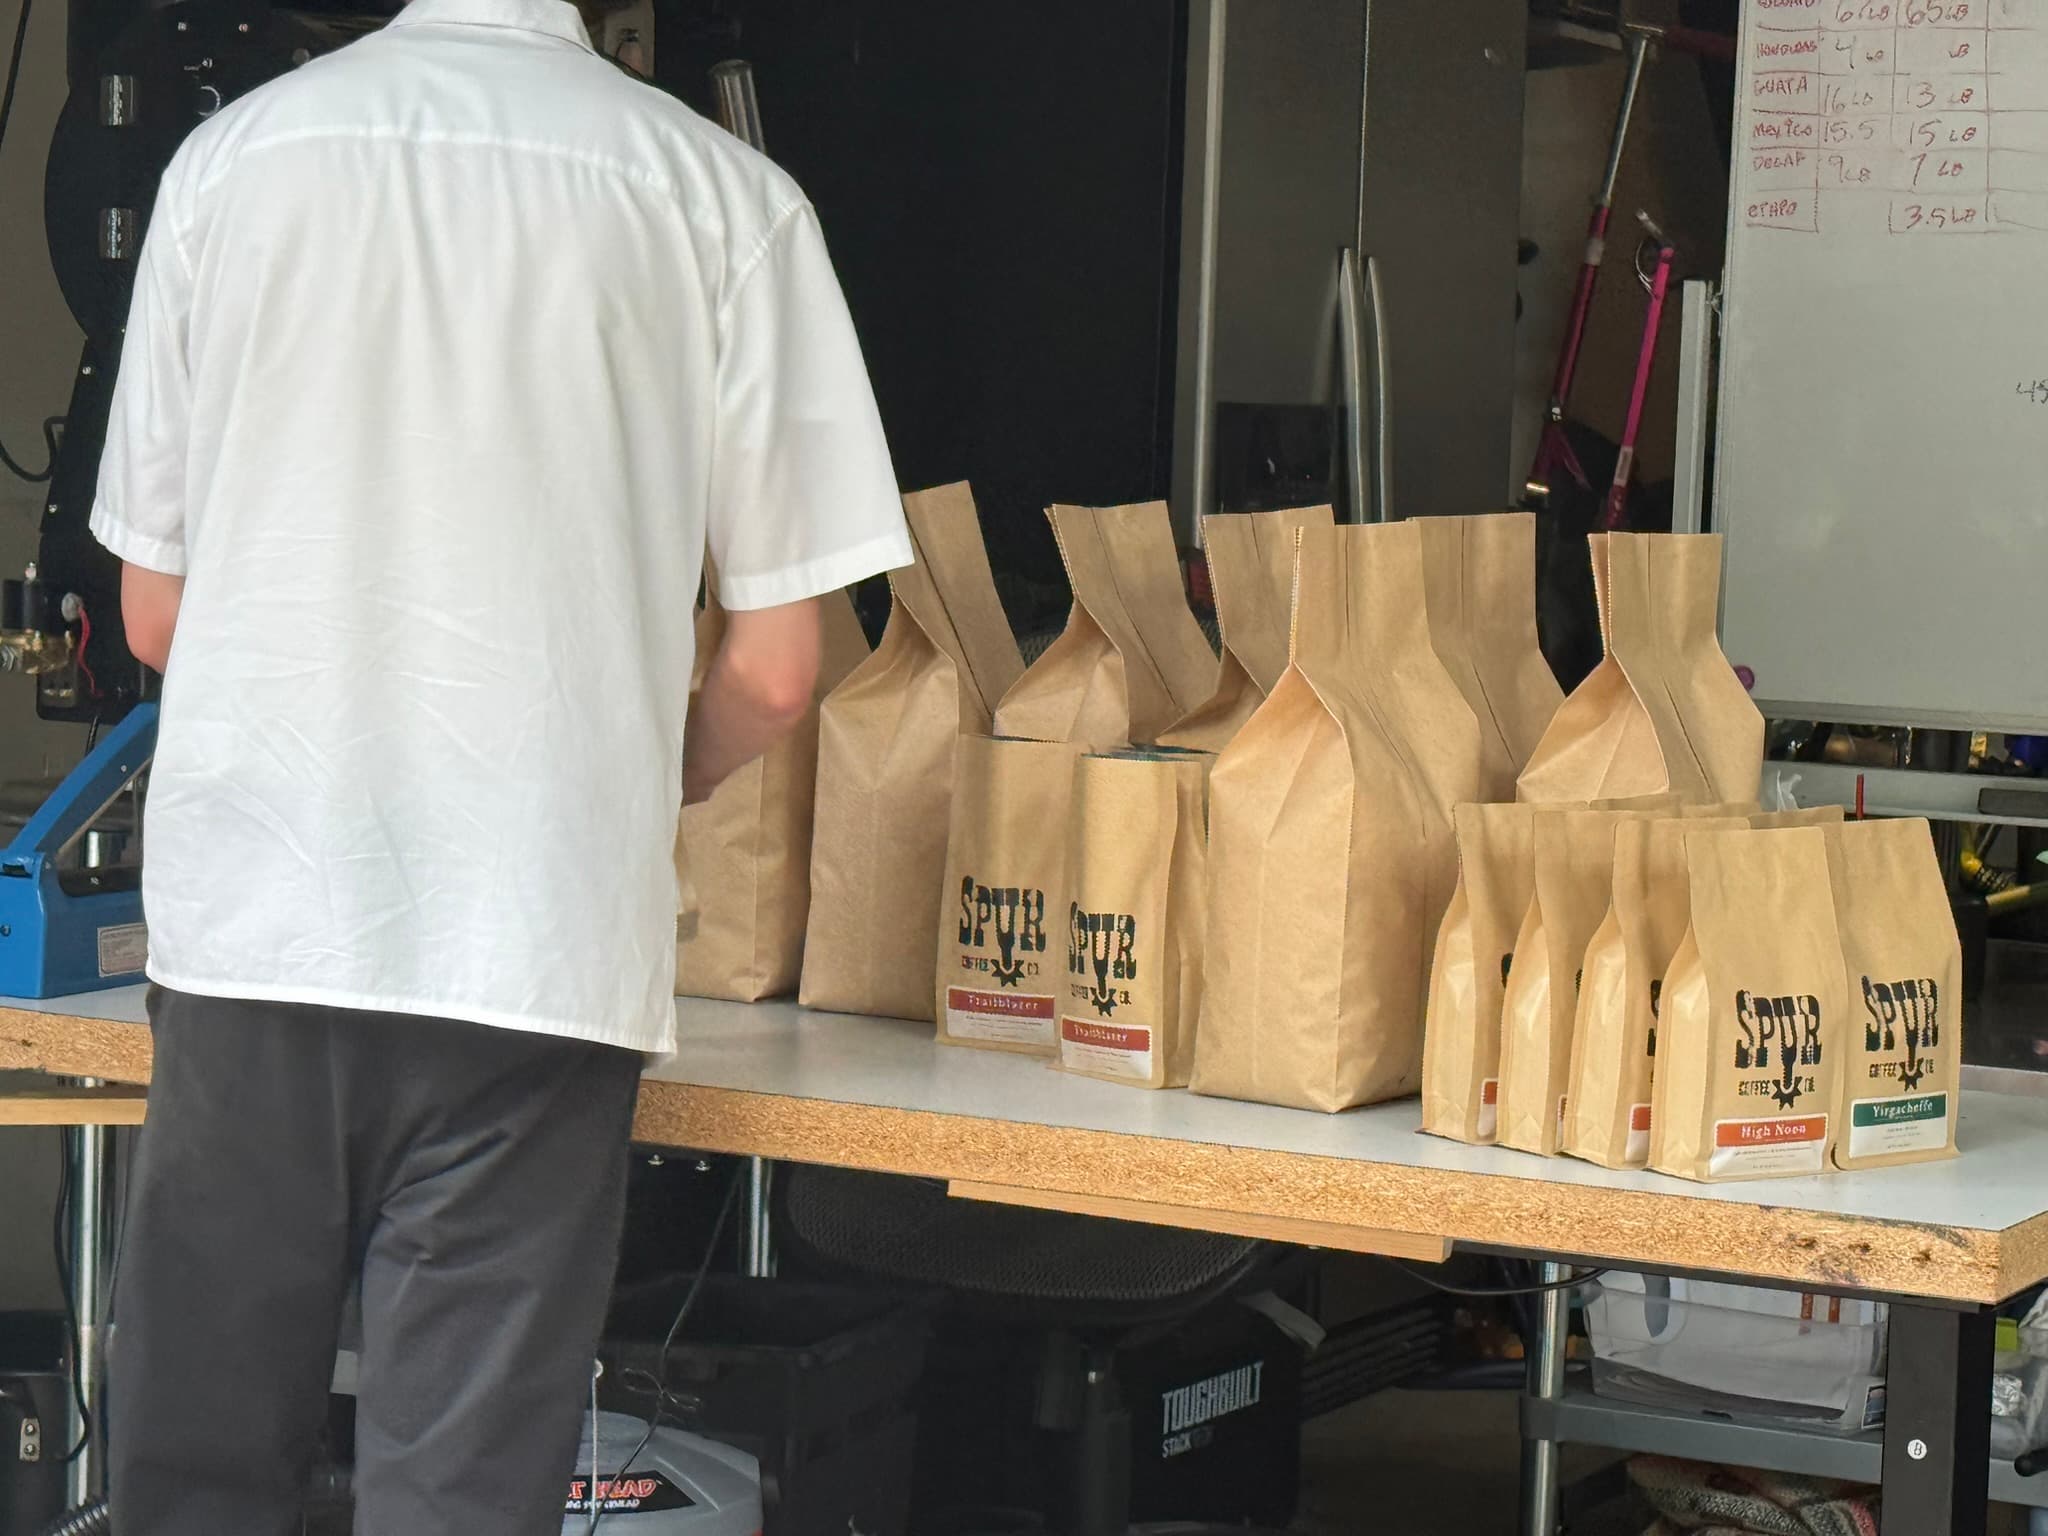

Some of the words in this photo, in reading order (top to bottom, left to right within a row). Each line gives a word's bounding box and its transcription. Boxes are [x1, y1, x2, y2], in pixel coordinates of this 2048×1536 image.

[958, 875, 1047, 972] SPUR
[1068, 901, 1137, 998] SPUR
[1735, 989, 1823, 1090] SPUR
[1861, 975, 1939, 1074] SPUR
[1741, 1125, 1771, 1140] High
[1775, 1123, 1806, 1137] Noon
[1872, 1099, 1934, 1120] Yirgacheffe
[1162, 1361, 1264, 1435] TOUGHBUILT
